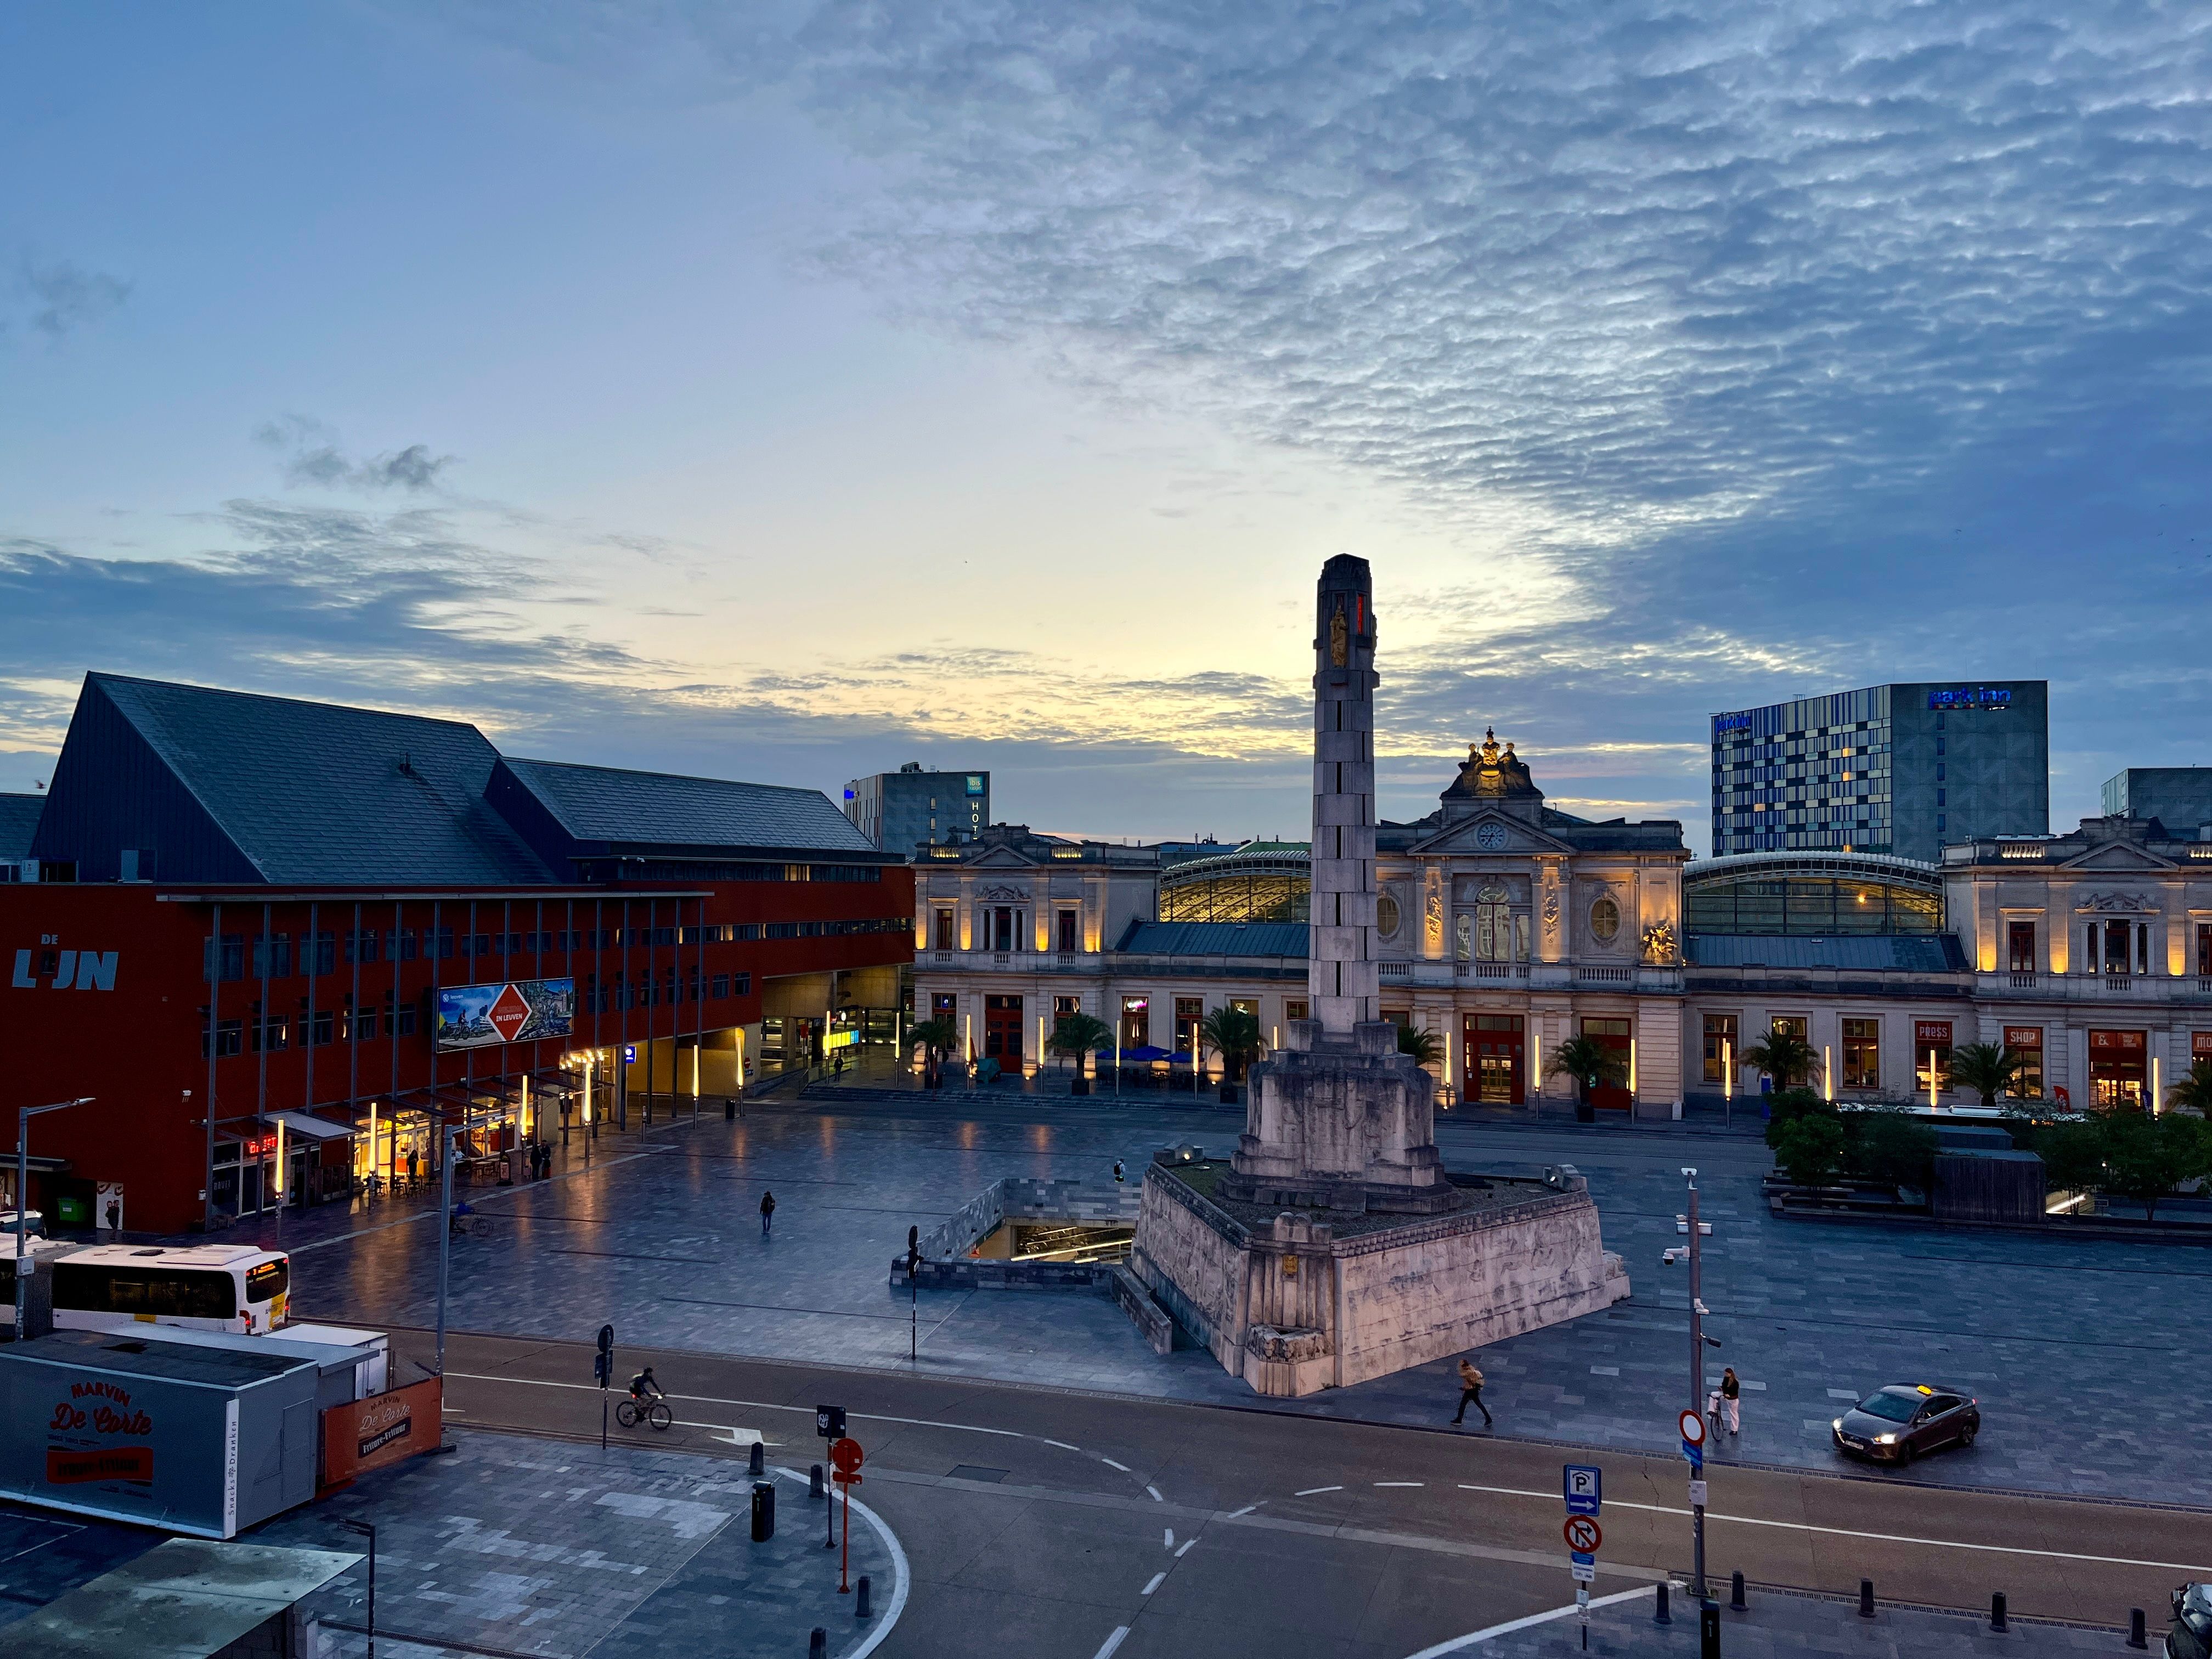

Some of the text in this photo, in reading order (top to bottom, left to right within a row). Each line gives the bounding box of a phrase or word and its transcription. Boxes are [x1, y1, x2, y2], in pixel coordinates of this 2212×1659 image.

[1928, 687, 1974, 709] park
[1978, 687, 2011, 702] inn
[41, 934, 59, 944] DE
[2010, 1031, 2035, 1043] SHOP
[2098, 1035, 2109, 1046] &
[71, 1382, 131, 1407] MARVIN
[370, 1395, 400, 1411] MARVIN
[49, 1403, 153, 1435] De Corte
[359, 1404, 410, 1431] De Corte
[363, 1424, 406, 1453] Friture-Frituur
[227, 1421, 238, 1515] Snacks Dranken
[1576, 1476, 1587, 1492] P
